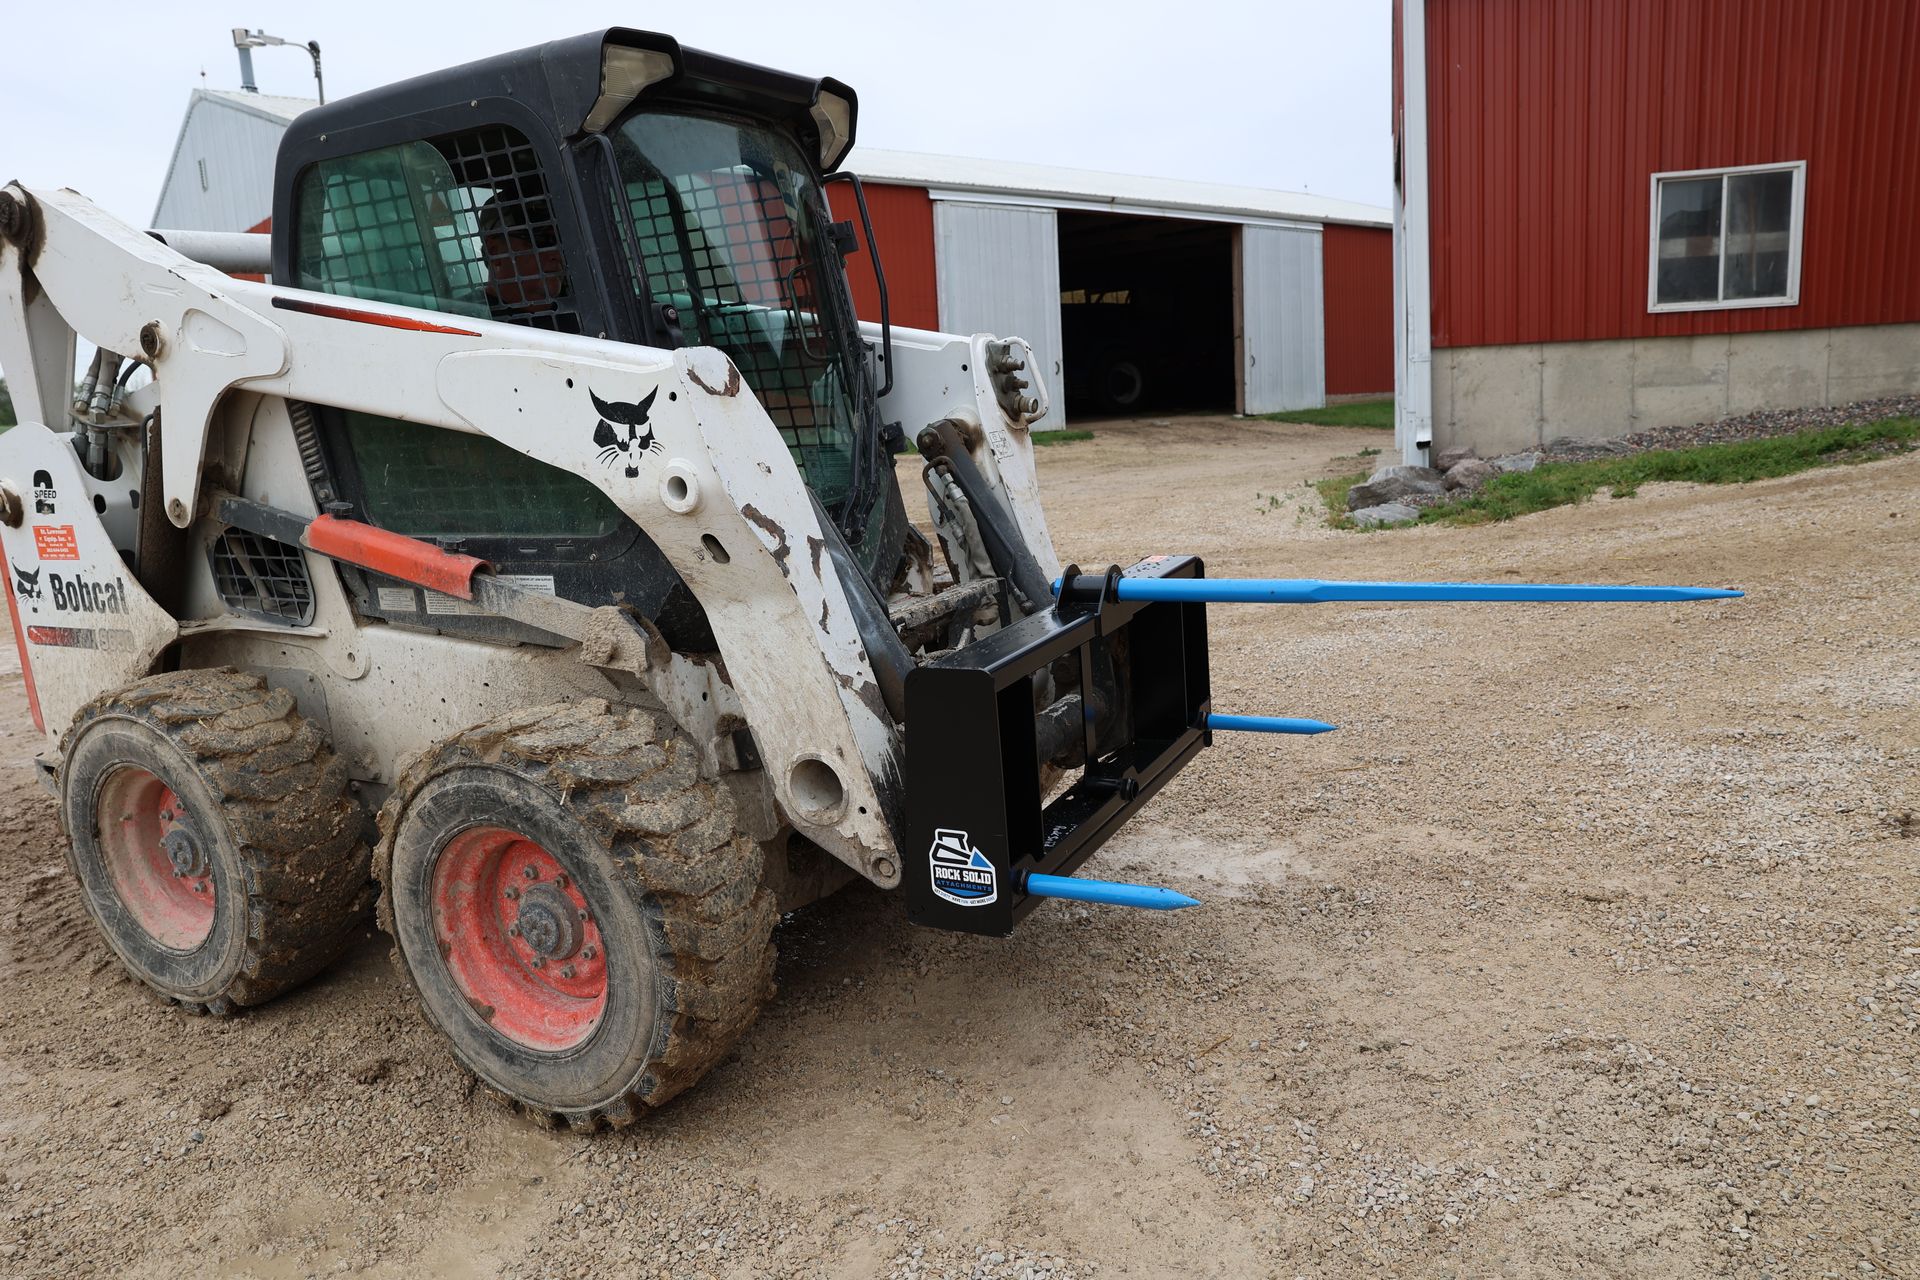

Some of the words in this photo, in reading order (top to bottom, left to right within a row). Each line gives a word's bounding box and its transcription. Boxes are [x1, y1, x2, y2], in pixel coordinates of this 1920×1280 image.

[34, 489, 57, 499] SPEED
[49, 573, 129, 615] Bobcat
[935, 867, 960, 880] ROCK
[963, 871, 991, 884] SOLID
[936, 880, 992, 891] ATTACHMENTS
